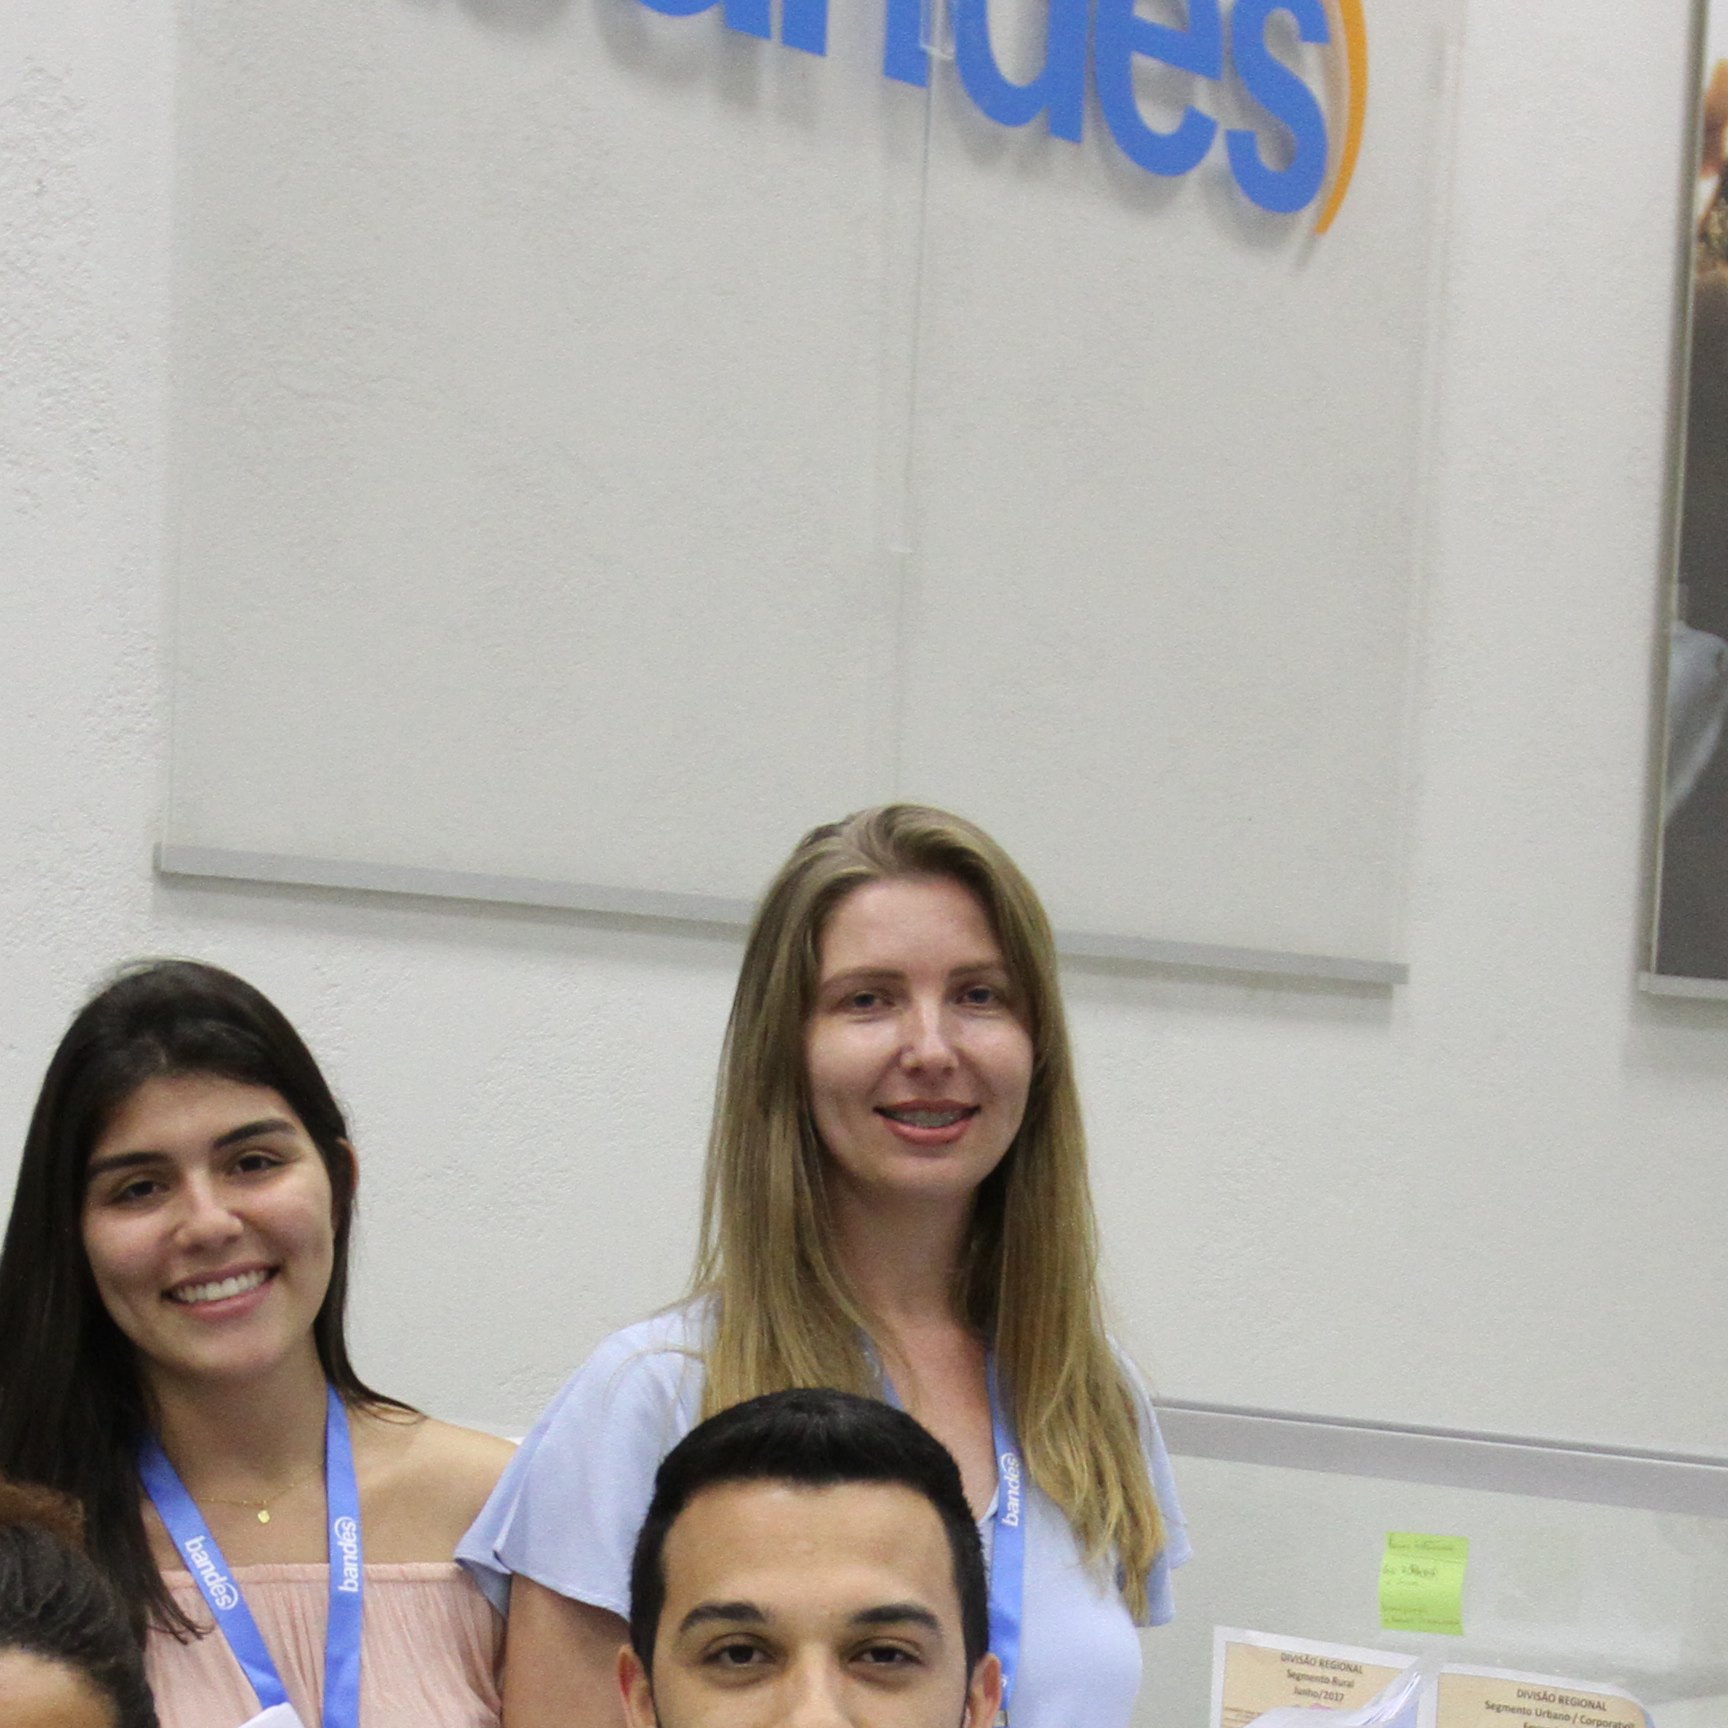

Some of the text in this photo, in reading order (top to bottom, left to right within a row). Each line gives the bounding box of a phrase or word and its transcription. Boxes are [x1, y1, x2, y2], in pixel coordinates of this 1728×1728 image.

[1000, 1452, 1020, 1526] bandes
[335, 1515, 357, 1593] bandes
[184, 1534, 239, 1610] bandes
[1280, 1652, 1363, 1674] DIVISÃO REGIONAL
[1287, 1668, 1355, 1688] Segmento Rural
[1294, 1686, 1344, 1702] Junho/2017
[1516, 1688, 1607, 1711] DIVISÃO REGIONAL
[1484, 1700, 1532, 1716] Segmento
[1535, 1708, 1570, 1722] Urbano
